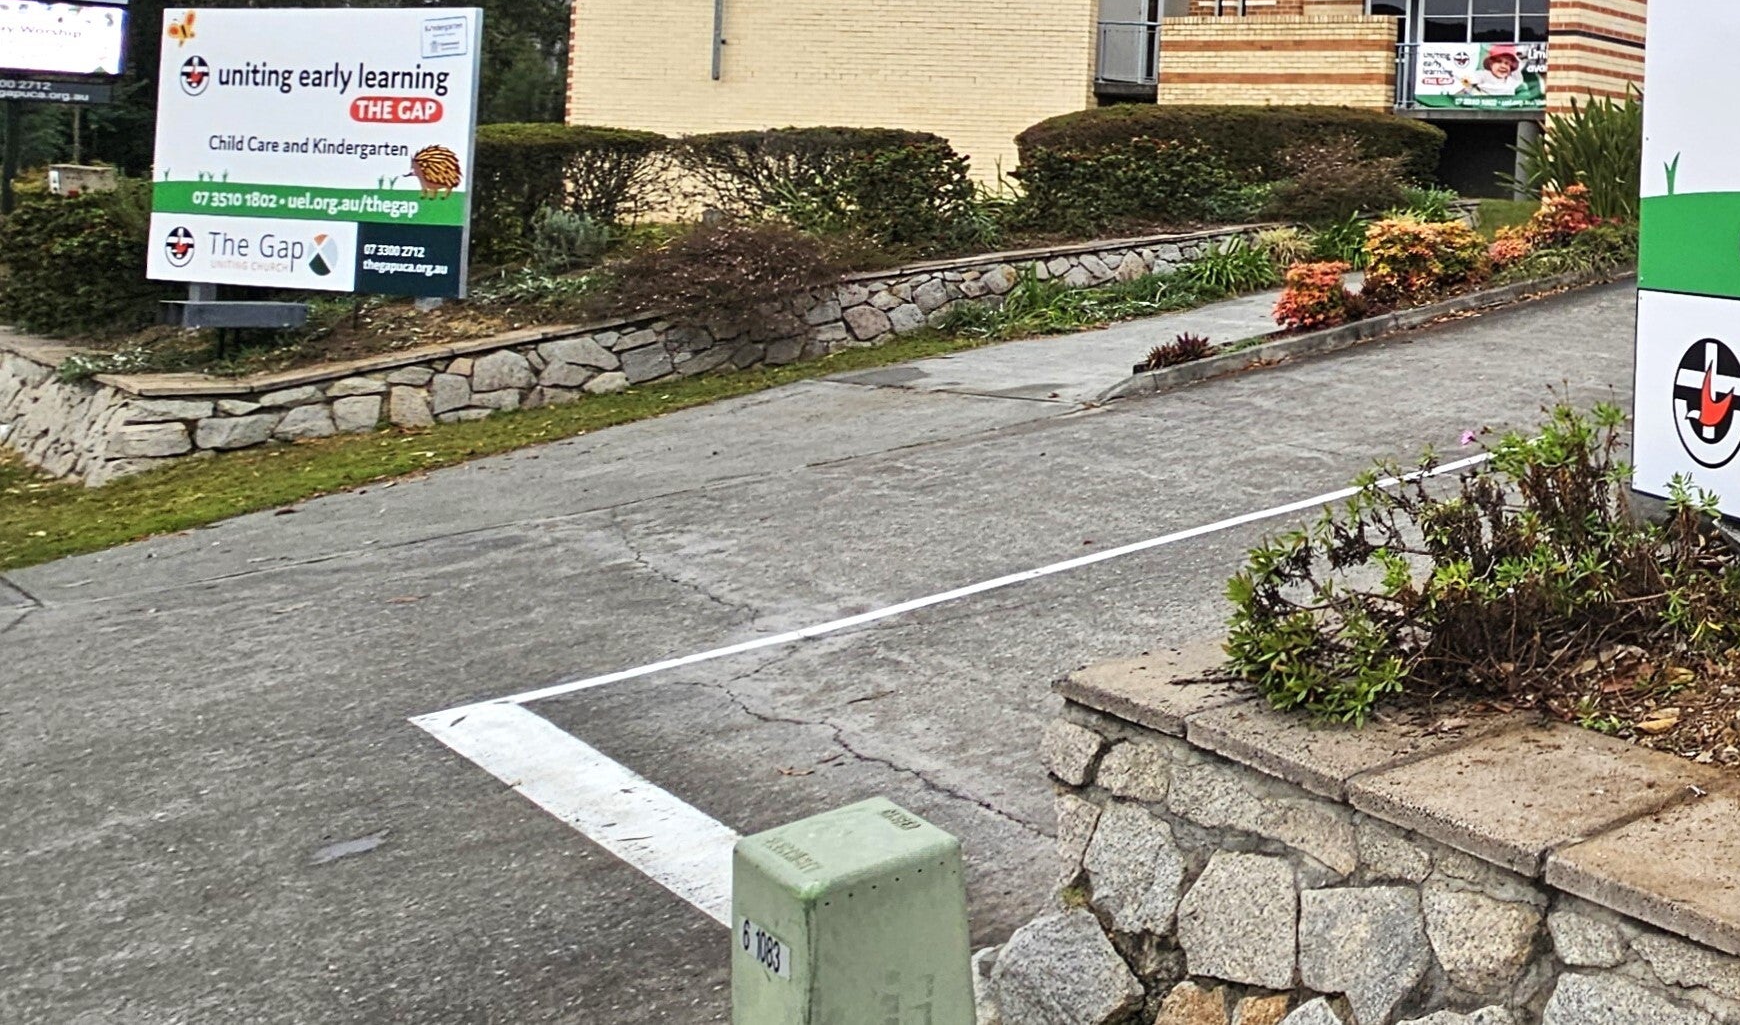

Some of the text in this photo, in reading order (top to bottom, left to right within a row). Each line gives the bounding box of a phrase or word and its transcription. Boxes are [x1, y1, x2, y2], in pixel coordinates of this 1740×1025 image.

[18, 80, 52, 91] 2712
[218, 62, 450, 96] uniting early learning
[356, 100, 437, 120] THE GAP
[209, 134, 409, 160] Child Care and Kindergarten
[192, 191, 419, 219] 07 3510 1802 uel.org.au/thegap
[208, 231, 304, 272] The Gap
[363, 243, 425, 259] 07 3300 2712
[211, 259, 289, 273] UNITING CHURCH
[362, 259, 448, 277] thegapuca.org.au
[743, 919, 780, 973] 6 1083
